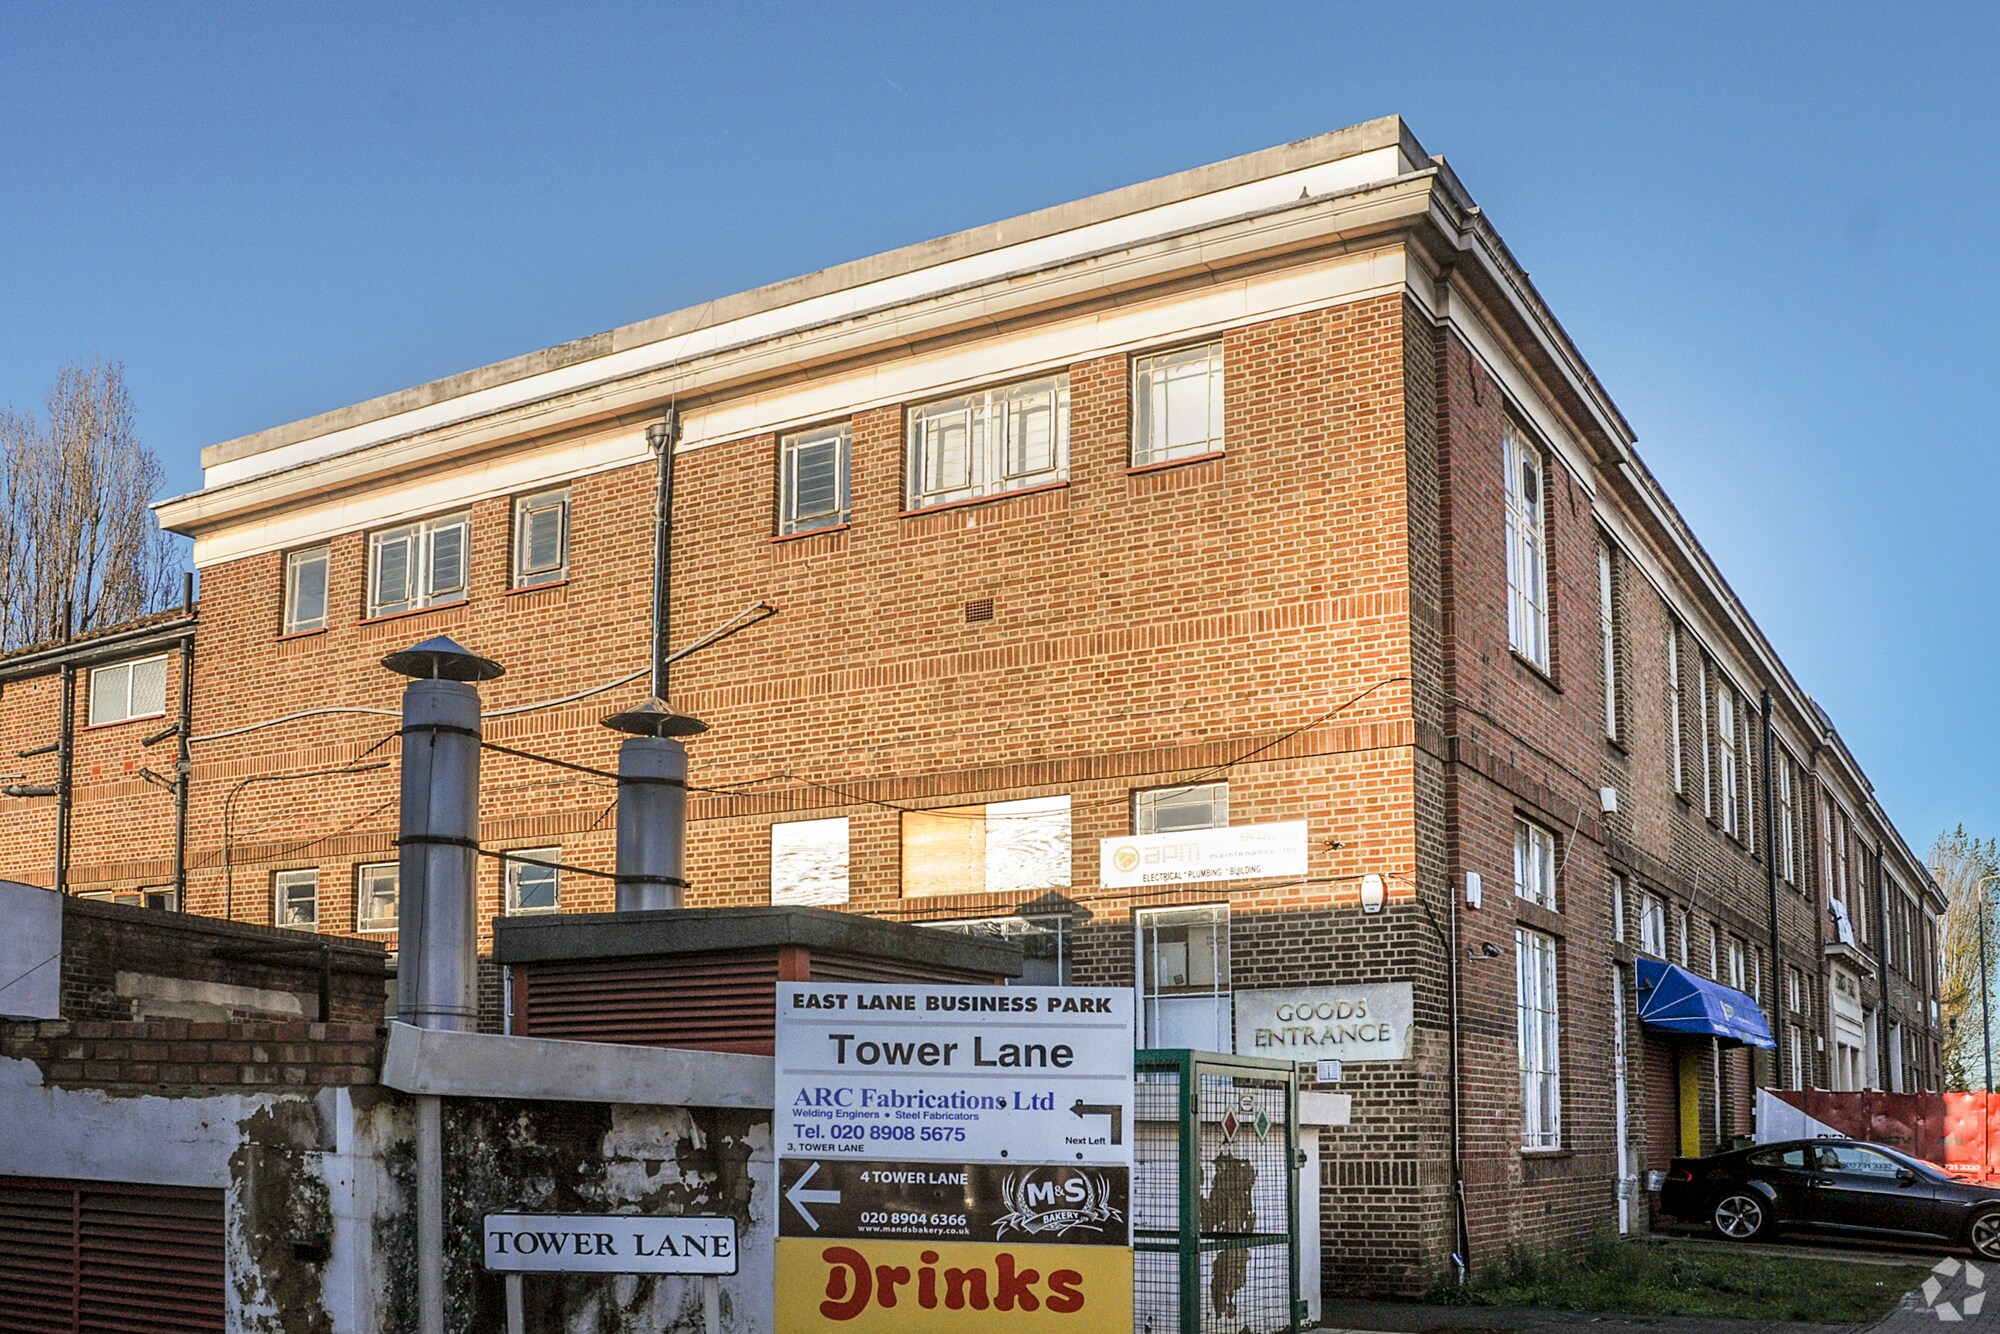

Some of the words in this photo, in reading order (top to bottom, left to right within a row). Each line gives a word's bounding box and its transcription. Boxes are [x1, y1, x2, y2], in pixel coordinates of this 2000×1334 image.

[1144, 842, 1201, 865] apm
[1209, 847, 1276, 859] maintenance
[1142, 871, 1182, 883] ELECTRICAL
[1187, 868, 1223, 879] PLUMBING
[1229, 865, 1261, 876] BUILDING
[793, 993, 848, 1009] EAST
[857, 994, 916, 1011] LANE
[925, 996, 1038, 1012] BUSINESS
[1047, 997, 1112, 1013] PARK
[1276, 999, 1367, 1022] GOODS
[1254, 1023, 1391, 1048] ENTRANCE
[828, 1034, 958, 1066] Tower
[973, 1036, 1074, 1068] Lane
[793, 1087, 853, 1107] ARC
[861, 1088, 1006, 1110] Fabrications
[1013, 1091, 1055, 1111] Ltd
[792, 1108, 834, 1120] Welding
[836, 1109, 880, 1120] Enginers
[895, 1110, 921, 1120] Steel
[923, 1110, 979, 1121] Fabricators
[793, 1124, 825, 1139] Tel.
[830, 1124, 865, 1140] 020
[869, 1126, 915, 1141] 8908
[920, 1126, 966, 1142] 5675
[1065, 1136, 1086, 1145] Next
[1088, 1136, 1106, 1145] Left
[787, 1143, 797, 1152] 3,
[799, 1143, 835, 1152] TOWER
[838, 1144, 865, 1152] LANE
[860, 1171, 870, 1182] 4
[872, 1171, 926, 1184] TOWER
[929, 1173, 968, 1185] LANE
[1027, 1178, 1086, 1207] M&S
[861, 1212, 888, 1223] 020
[891, 1212, 927, 1224] 8904
[930, 1214, 966, 1225] 6366
[1043, 1211, 1078, 1224] BAKERY
[858, 1226, 970, 1235] www.mandsbakery.co.uk
[489, 1231, 618, 1255] TOWER
[634, 1234, 732, 1258] LANE
[819, 1246, 1085, 1321] Drinks
